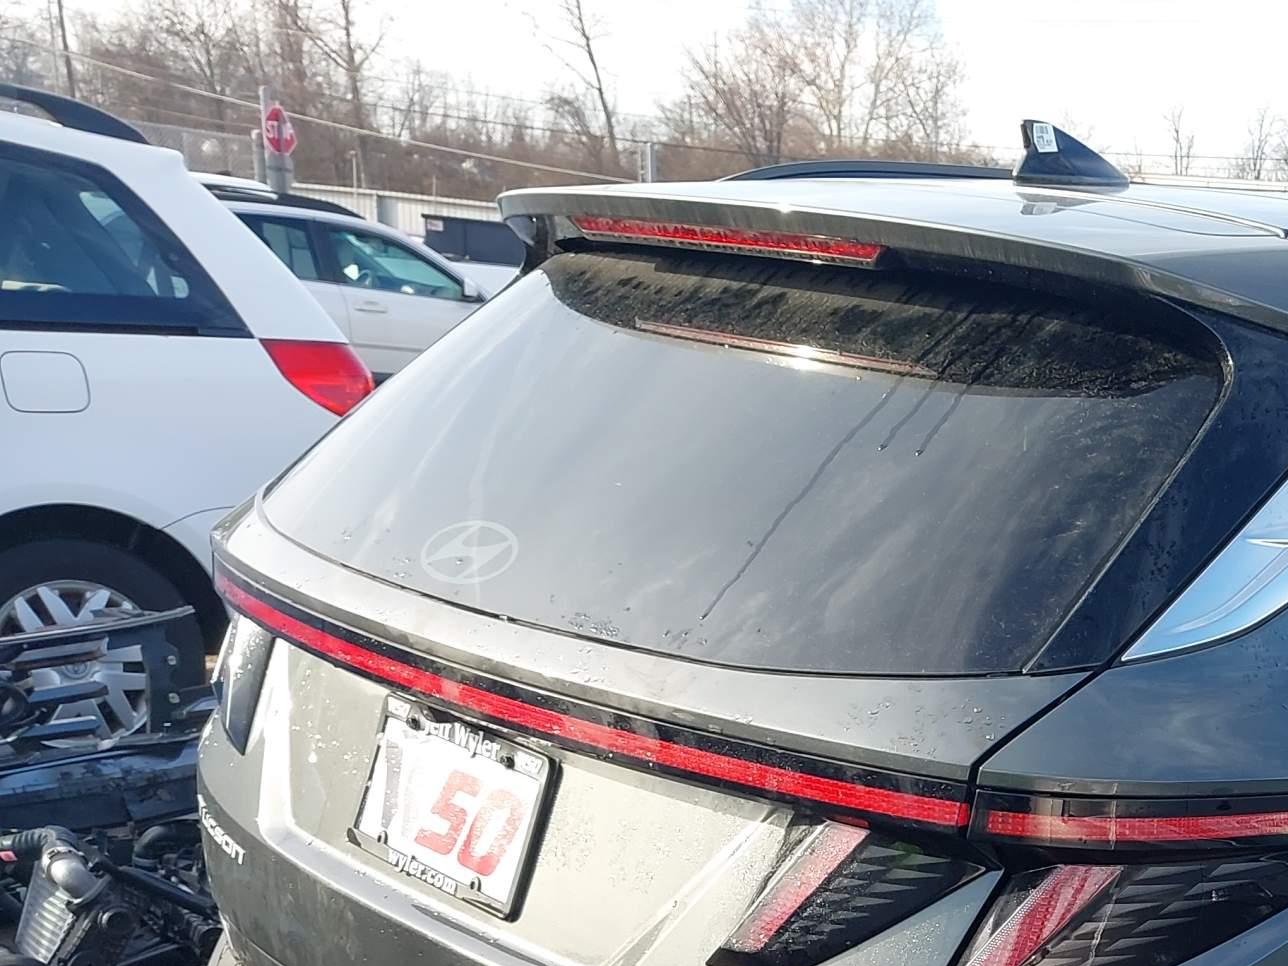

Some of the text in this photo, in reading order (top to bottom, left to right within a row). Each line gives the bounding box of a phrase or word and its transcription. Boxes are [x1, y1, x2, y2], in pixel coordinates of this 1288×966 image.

[454, 722, 501, 761] Wyler
[414, 769, 524, 877] 50
[388, 848, 457, 896] wyler.com
